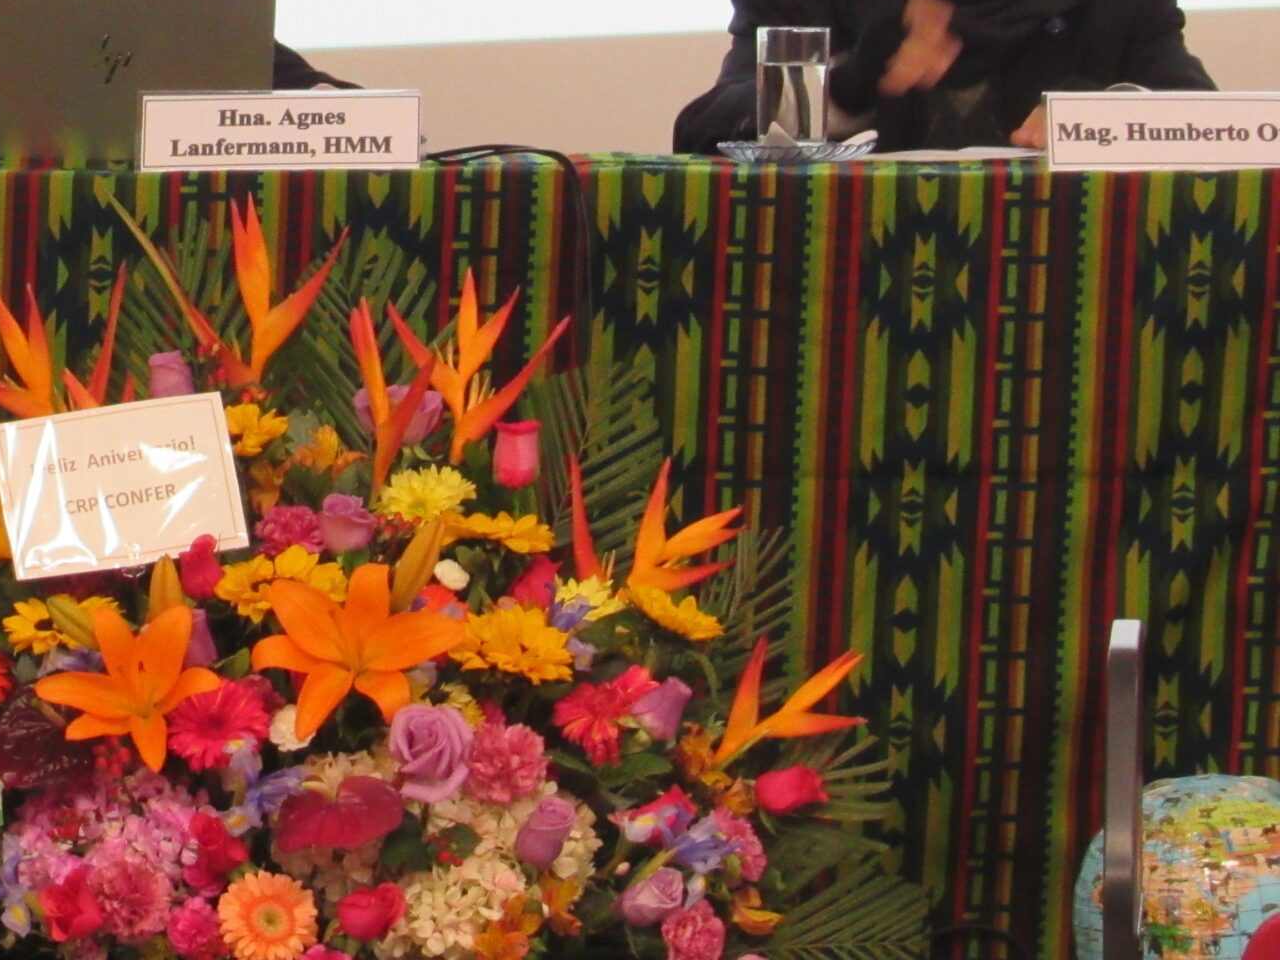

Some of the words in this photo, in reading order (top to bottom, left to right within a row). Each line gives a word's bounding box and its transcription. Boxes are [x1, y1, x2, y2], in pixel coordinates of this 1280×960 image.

[218, 108, 272, 127] Hna.
[279, 108, 346, 130] Agnes
[1056, 122, 1118, 146] Mag.
[1125, 122, 1250, 142] Humberto
[1257, 122, 1280, 142] O
[170, 137, 316, 158] Lanfermann,
[323, 135, 393, 154] HMM
[65, 496, 99, 515] CRP
[104, 483, 177, 509] CONFER
